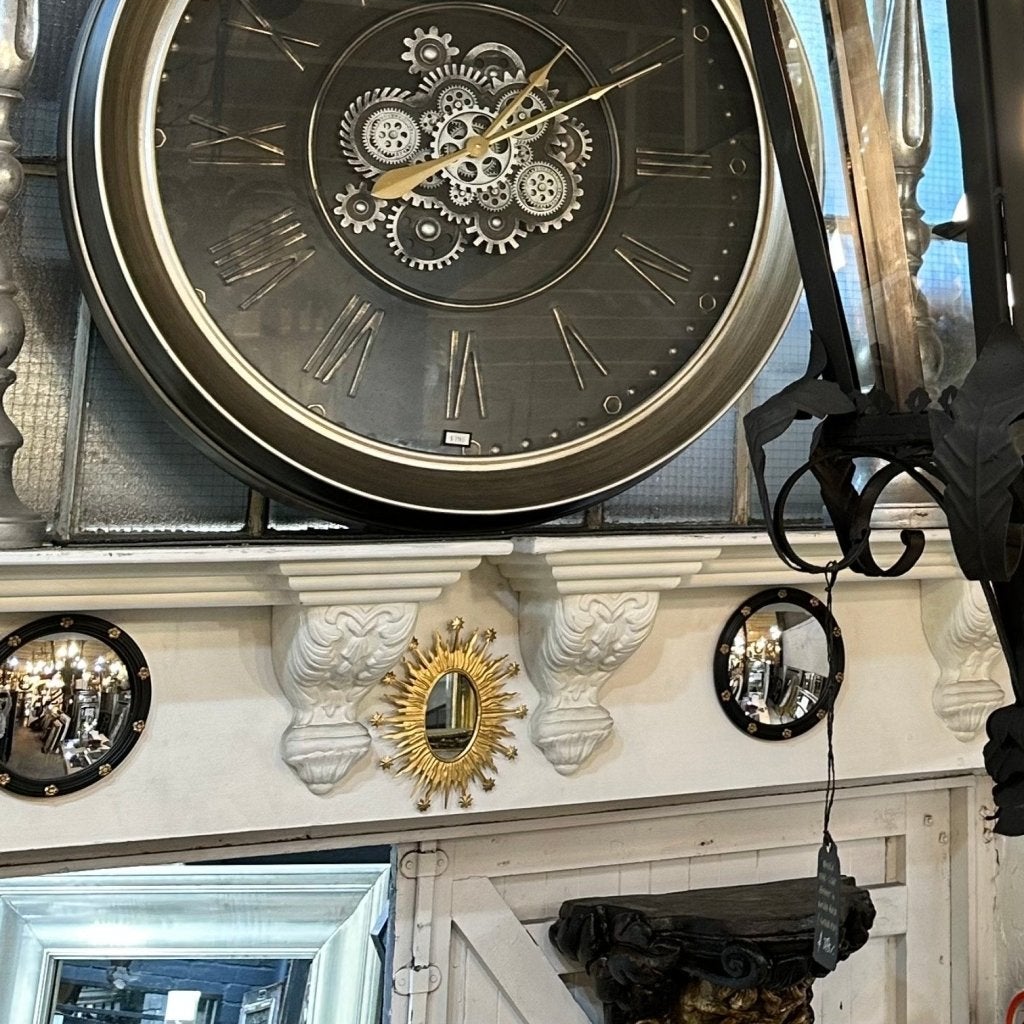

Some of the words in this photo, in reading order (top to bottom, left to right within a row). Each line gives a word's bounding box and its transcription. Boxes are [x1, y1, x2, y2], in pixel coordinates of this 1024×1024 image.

[187, 114, 287, 165] IX
[636, 148, 712, 179] III
[209, 207, 316, 310] VIII
[615, 233, 692, 304] IV
[303, 294, 385, 398] VII
[446, 330, 486, 418] VI
[553, 307, 608, 389] V
